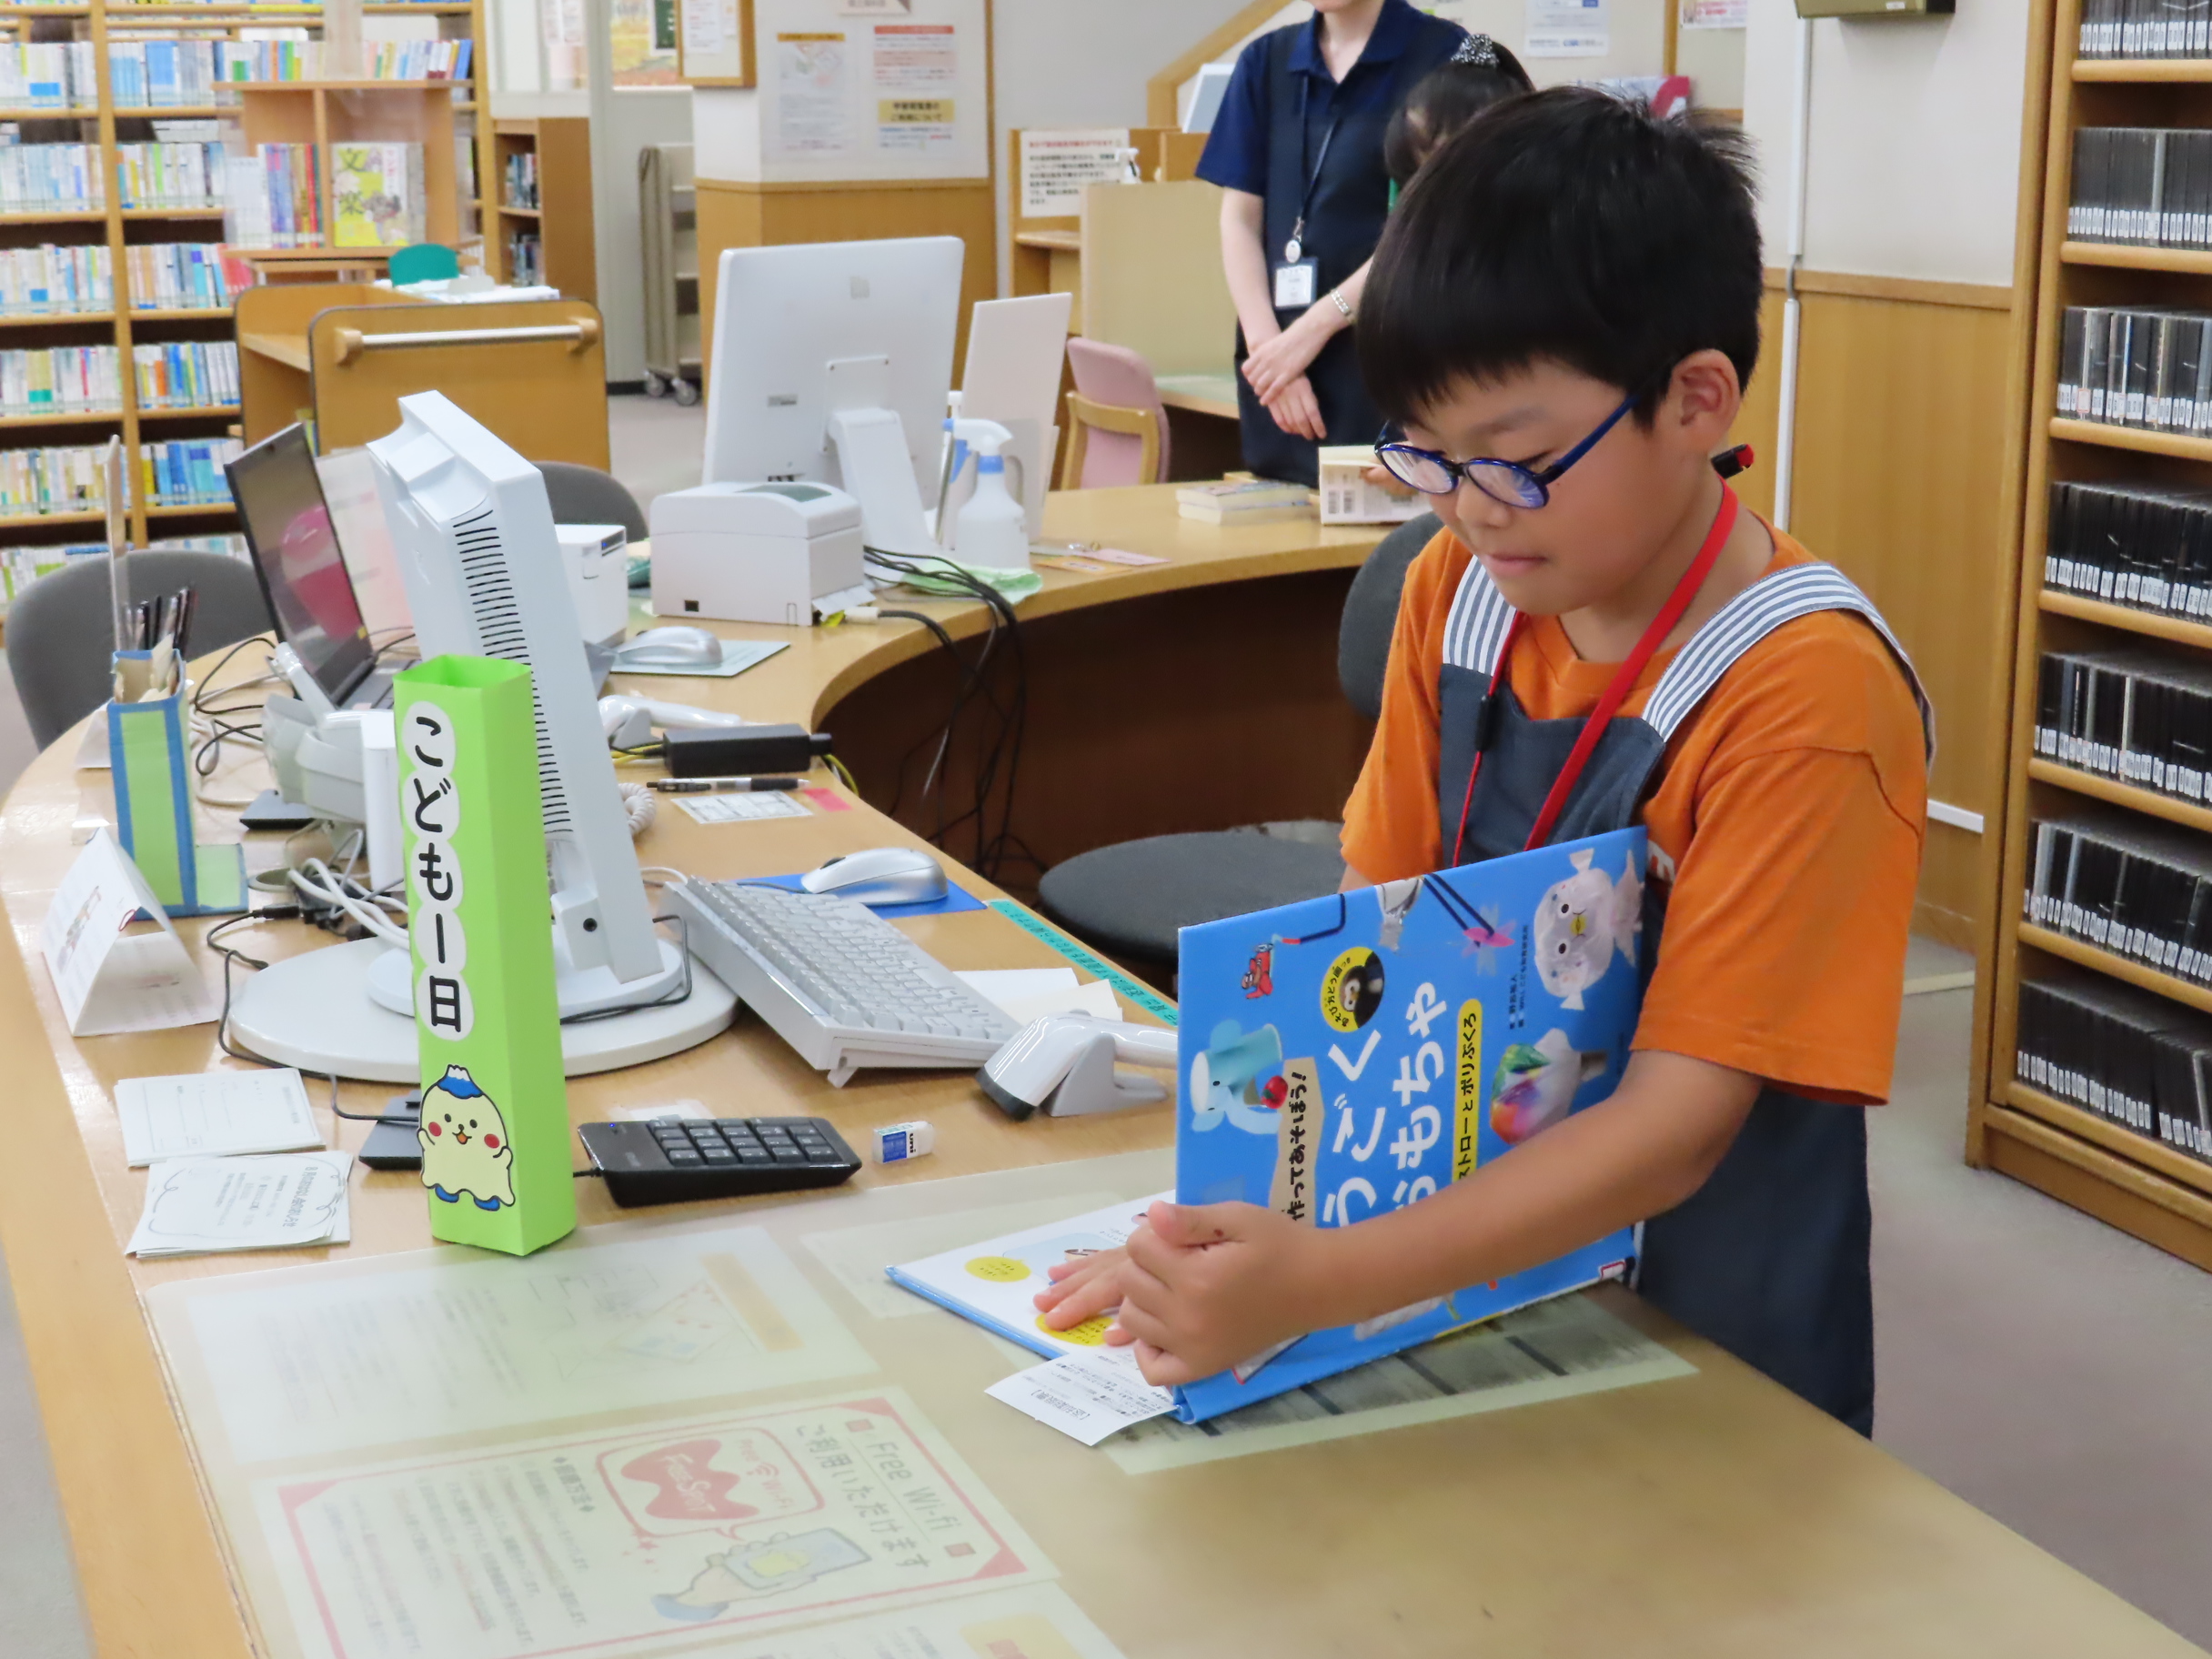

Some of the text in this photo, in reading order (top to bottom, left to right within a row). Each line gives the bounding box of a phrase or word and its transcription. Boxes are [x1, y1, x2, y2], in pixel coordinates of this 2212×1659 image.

[909, 1132, 917, 1154] uni
[1322, 1029, 1386, 1228] うごく
[795, 1423, 933, 1568] ご利用いただけます
[866, 1441, 913, 1481] Free
